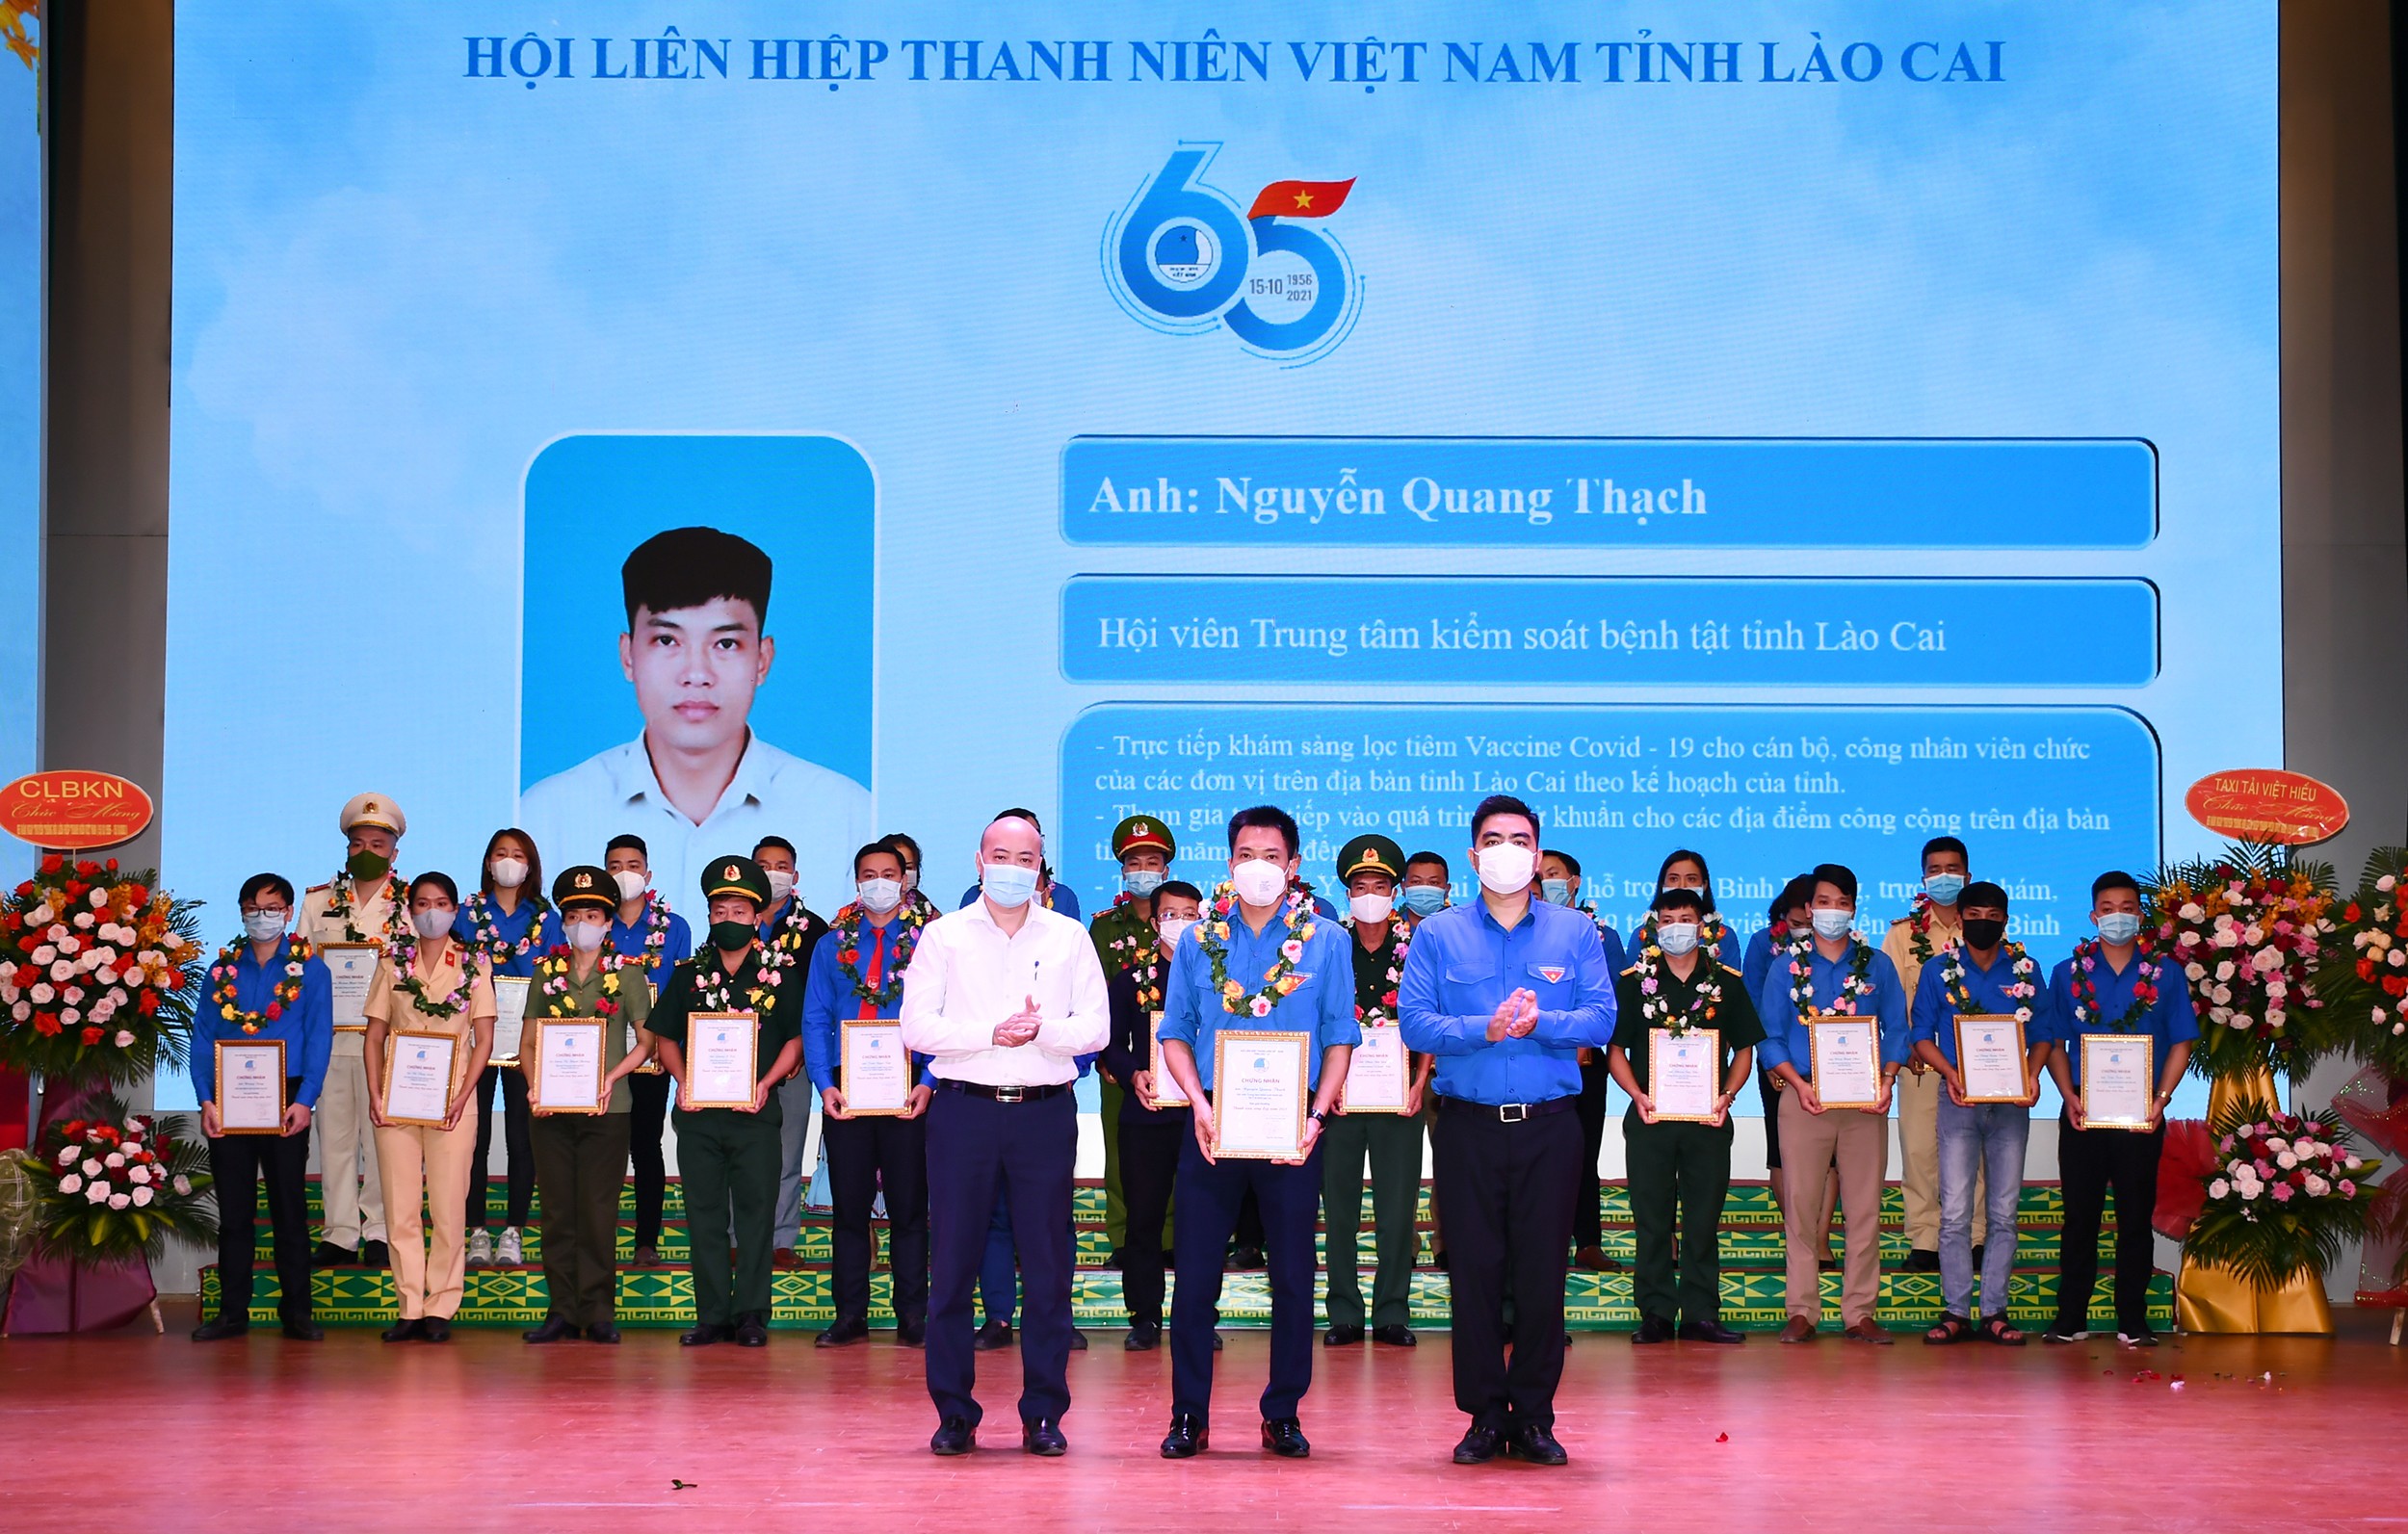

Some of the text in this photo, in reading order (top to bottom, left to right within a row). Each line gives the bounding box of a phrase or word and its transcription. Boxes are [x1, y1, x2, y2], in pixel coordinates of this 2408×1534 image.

[462, 25, 2006, 93] HỘI LIÊN HIỆP THANH NIÊN VIỆT NAM TỈNH LÀO CAI
[1286, 273, 1313, 286] 1956
[1286, 290, 1313, 301] 2021
[1089, 468, 1708, 526] Anh: Nguyễn Quang Thạch
[1100, 611, 1947, 658] Hội viên Trung tâm kiểm soát bệnh tật tỉnh Lào Cai
[1112, 735, 1168, 760] Trực
[1177, 728, 1221, 762] tiếp
[1228, 734, 1294, 756] khám
[1301, 736, 1354, 763] sàng
[1363, 735, 1398, 761] lọc
[1405, 735, 1457, 757] tiêm
[1465, 736, 1562, 758] Vaccine
[1569, 736, 1641, 758] Covid
[1668, 737, 1694, 758] 19
[1702, 737, 1745, 759] cho
[1752, 737, 1793, 759] cán
[1800, 737, 1837, 763] bộ,
[1845, 737, 1902, 765] công
[1910, 737, 1968, 759] nhân
[1976, 737, 2027, 760] viên
[2033, 737, 2090, 760] chức
[19, 780, 124, 798] CLBKN
[1095, 766, 1845, 797] của các đơn vị trên địa bàn tỉnh Lào Cai theo kế hoạch của tỉnh.
[2214, 776, 2317, 802] TAXI TẢI VIỆT HIẾU
[1188, 808, 1224, 832] gia
[1288, 798, 1329, 832] iếp
[1338, 805, 1380, 827] vào
[1387, 806, 1430, 833] quá
[1437, 805, 1476, 827] trì
[1553, 800, 1626, 828] khuẩn
[1633, 806, 1675, 829] cho
[1683, 806, 1721, 829] các
[1729, 806, 1766, 833] địa
[1772, 801, 1832, 829] điểm
[1839, 807, 1897, 836] công
[1904, 808, 1962, 836] cộng
[1970, 808, 2016, 830] trên
[2023, 808, 2059, 834] địa
[2066, 808, 2111, 831] bàn
[1179, 842, 1230, 862] năm
[1449, 876, 1469, 897] ai
[1586, 873, 1615, 898] hỗ
[1717, 877, 1774, 899] Bình
[1985, 877, 2058, 902] hám,
[2004, 914, 2060, 936] Bình
